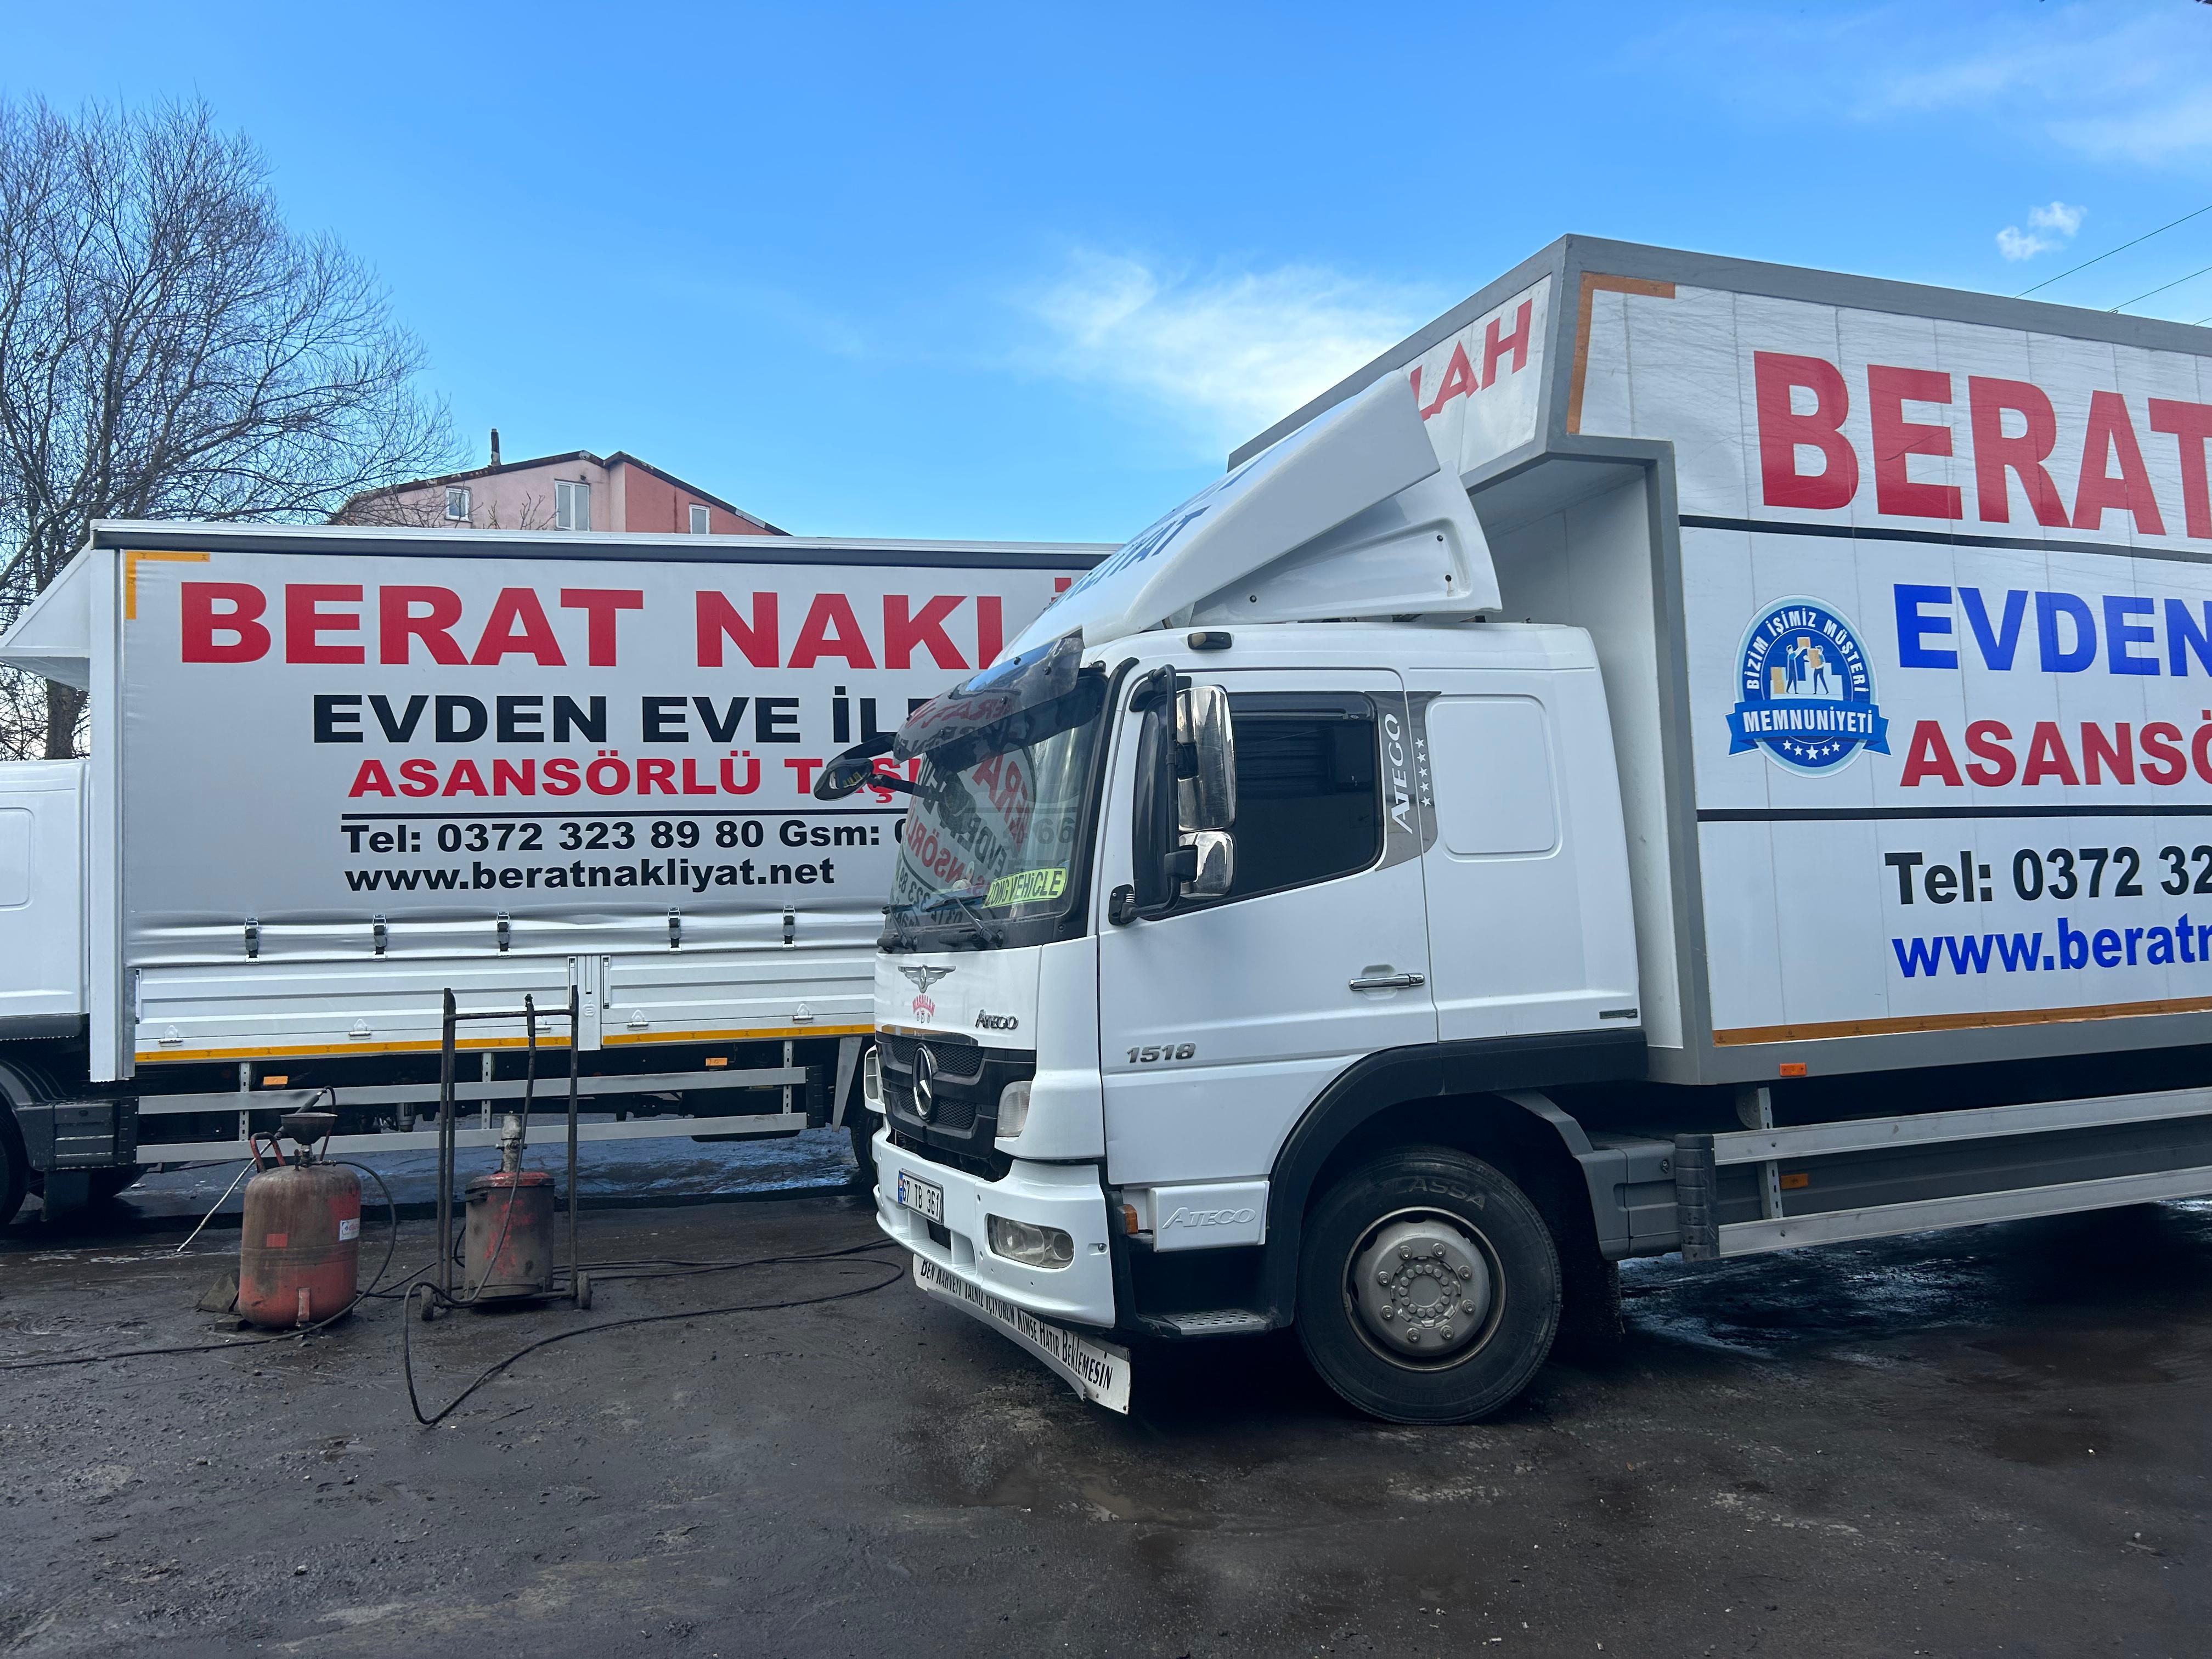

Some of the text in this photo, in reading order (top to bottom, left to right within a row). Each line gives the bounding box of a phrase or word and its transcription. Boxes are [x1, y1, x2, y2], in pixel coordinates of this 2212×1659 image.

[1754, 351, 2212, 539] BERAT
[181, 582, 644, 667] BERAT
[1893, 583, 2212, 677] EVDEN
[1743, 607, 1870, 693] BİZİM İŞİMİZ MÜŞTERİ
[313, 694, 607, 743] EVDEN
[642, 696, 801, 743] EVE
[1742, 706, 1873, 734] MEMNUNİYETİ
[348, 749, 761, 798] ASANSÖRLÜ
[1384, 713, 1413, 834] ATEGO
[341, 823, 421, 853] Tel:
[438, 822, 543, 852] 0372
[558, 821, 635, 850] 323
[651, 821, 700, 849] 89
[715, 820, 764, 849] 80
[778, 820, 880, 848] Gsm:
[344, 857, 836, 893] www.beratnakliyat.net
[1884, 844, 2212, 905] Tel: 0372 32
[975, 1009, 1019, 1030] ATEGO
[1126, 1042, 1197, 1064] 1518
[902, 1178, 940, 1217] 67 TB 361
[1162, 1206, 1257, 1229] ATEGO
[920, 1259, 936, 1282] BEN
[1039, 1321, 1060, 1358] HATIR
